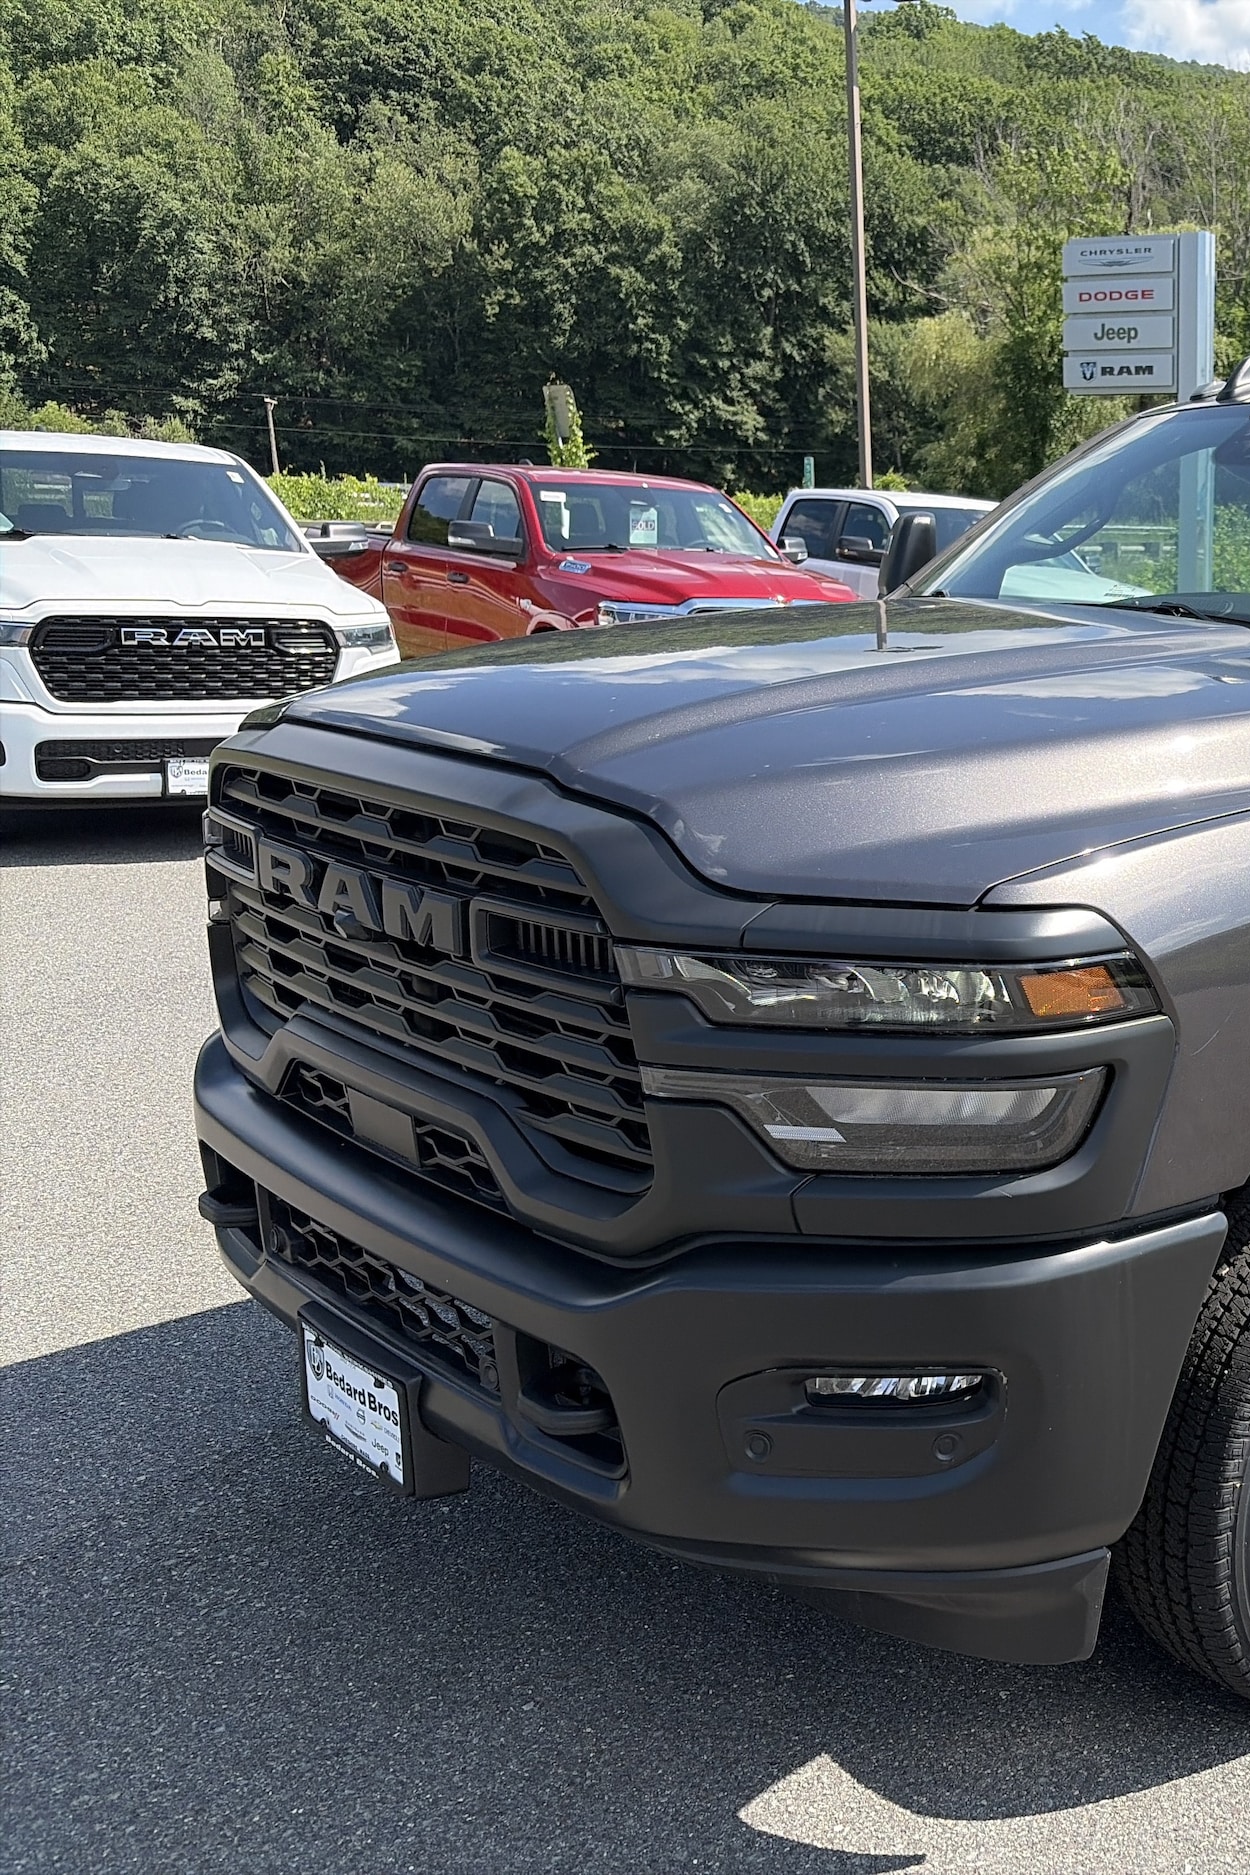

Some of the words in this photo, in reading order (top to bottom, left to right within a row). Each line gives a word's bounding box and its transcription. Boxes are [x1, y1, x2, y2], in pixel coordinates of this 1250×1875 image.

[1080, 247, 1152, 257] CHRYSLER
[1078, 289, 1155, 303] DODGE
[1093, 323, 1139, 344] Jeep
[1100, 365, 1154, 377] RAM
[632, 520, 655, 531] SOLD
[121, 628, 265, 646] RAM
[257, 836, 465, 957] RAM
[325, 1361, 368, 1408] Bedard
[367, 1391, 399, 1427] Bros
[371, 1438, 389, 1456] Jeep
[325, 1434, 355, 1461] Bedard
[356, 1457, 380, 1479] Bros.
